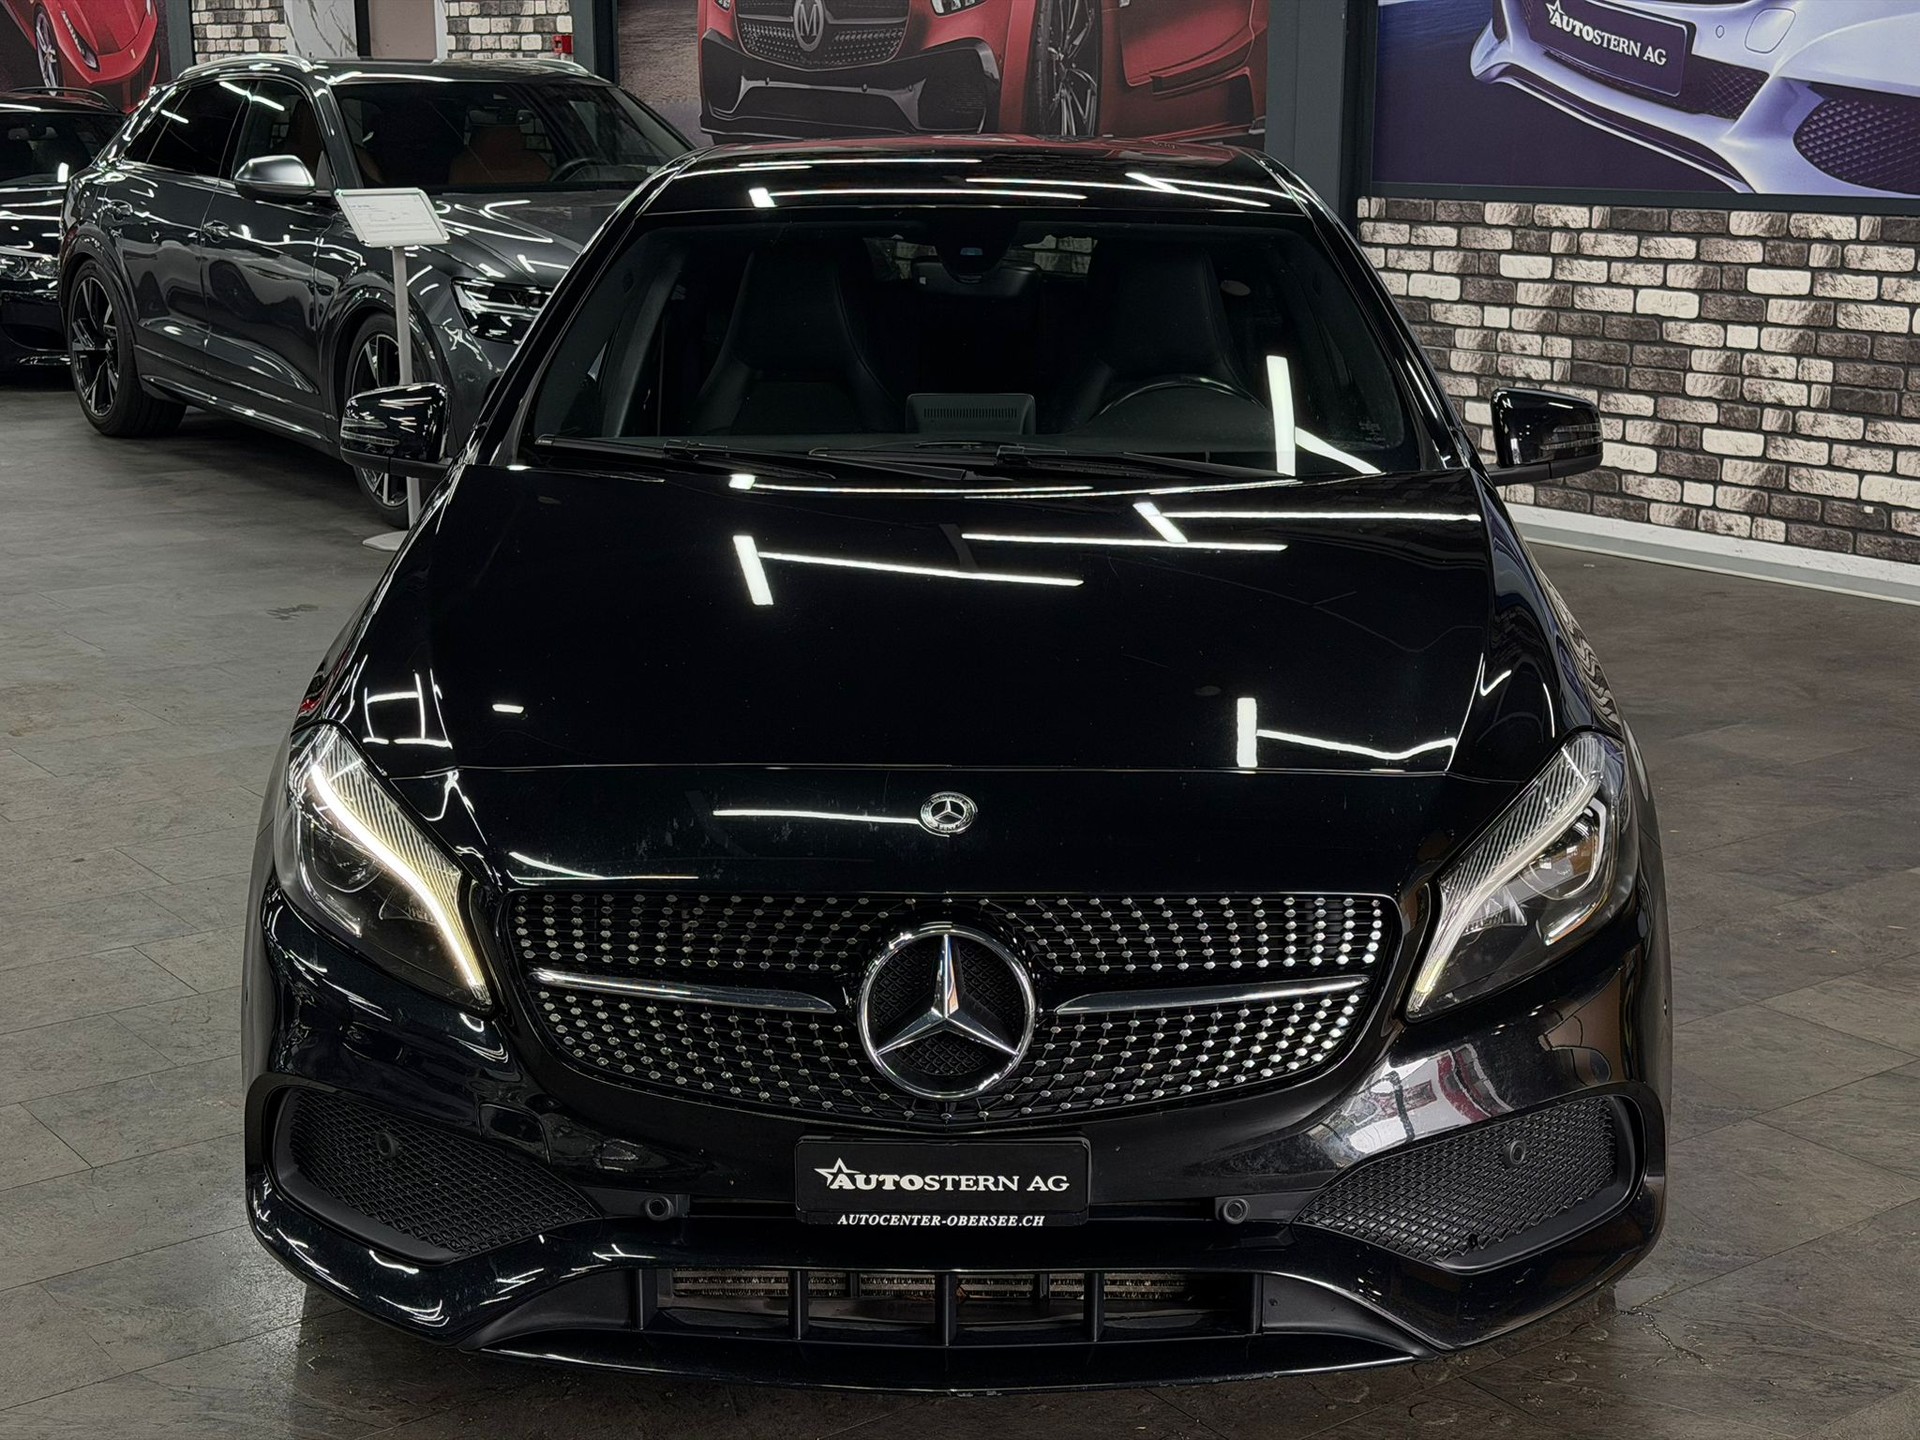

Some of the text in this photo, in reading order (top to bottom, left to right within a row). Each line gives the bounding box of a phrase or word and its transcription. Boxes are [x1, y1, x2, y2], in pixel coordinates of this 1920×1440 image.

[800, 4, 818, 36] M
[1550, 10, 1667, 66] AUTOSTERN AG
[829, 1173, 1070, 1192] AUTOSTERN AG
[837, 1214, 1045, 1227] AUTOCENTER-OBERSEE.CH
